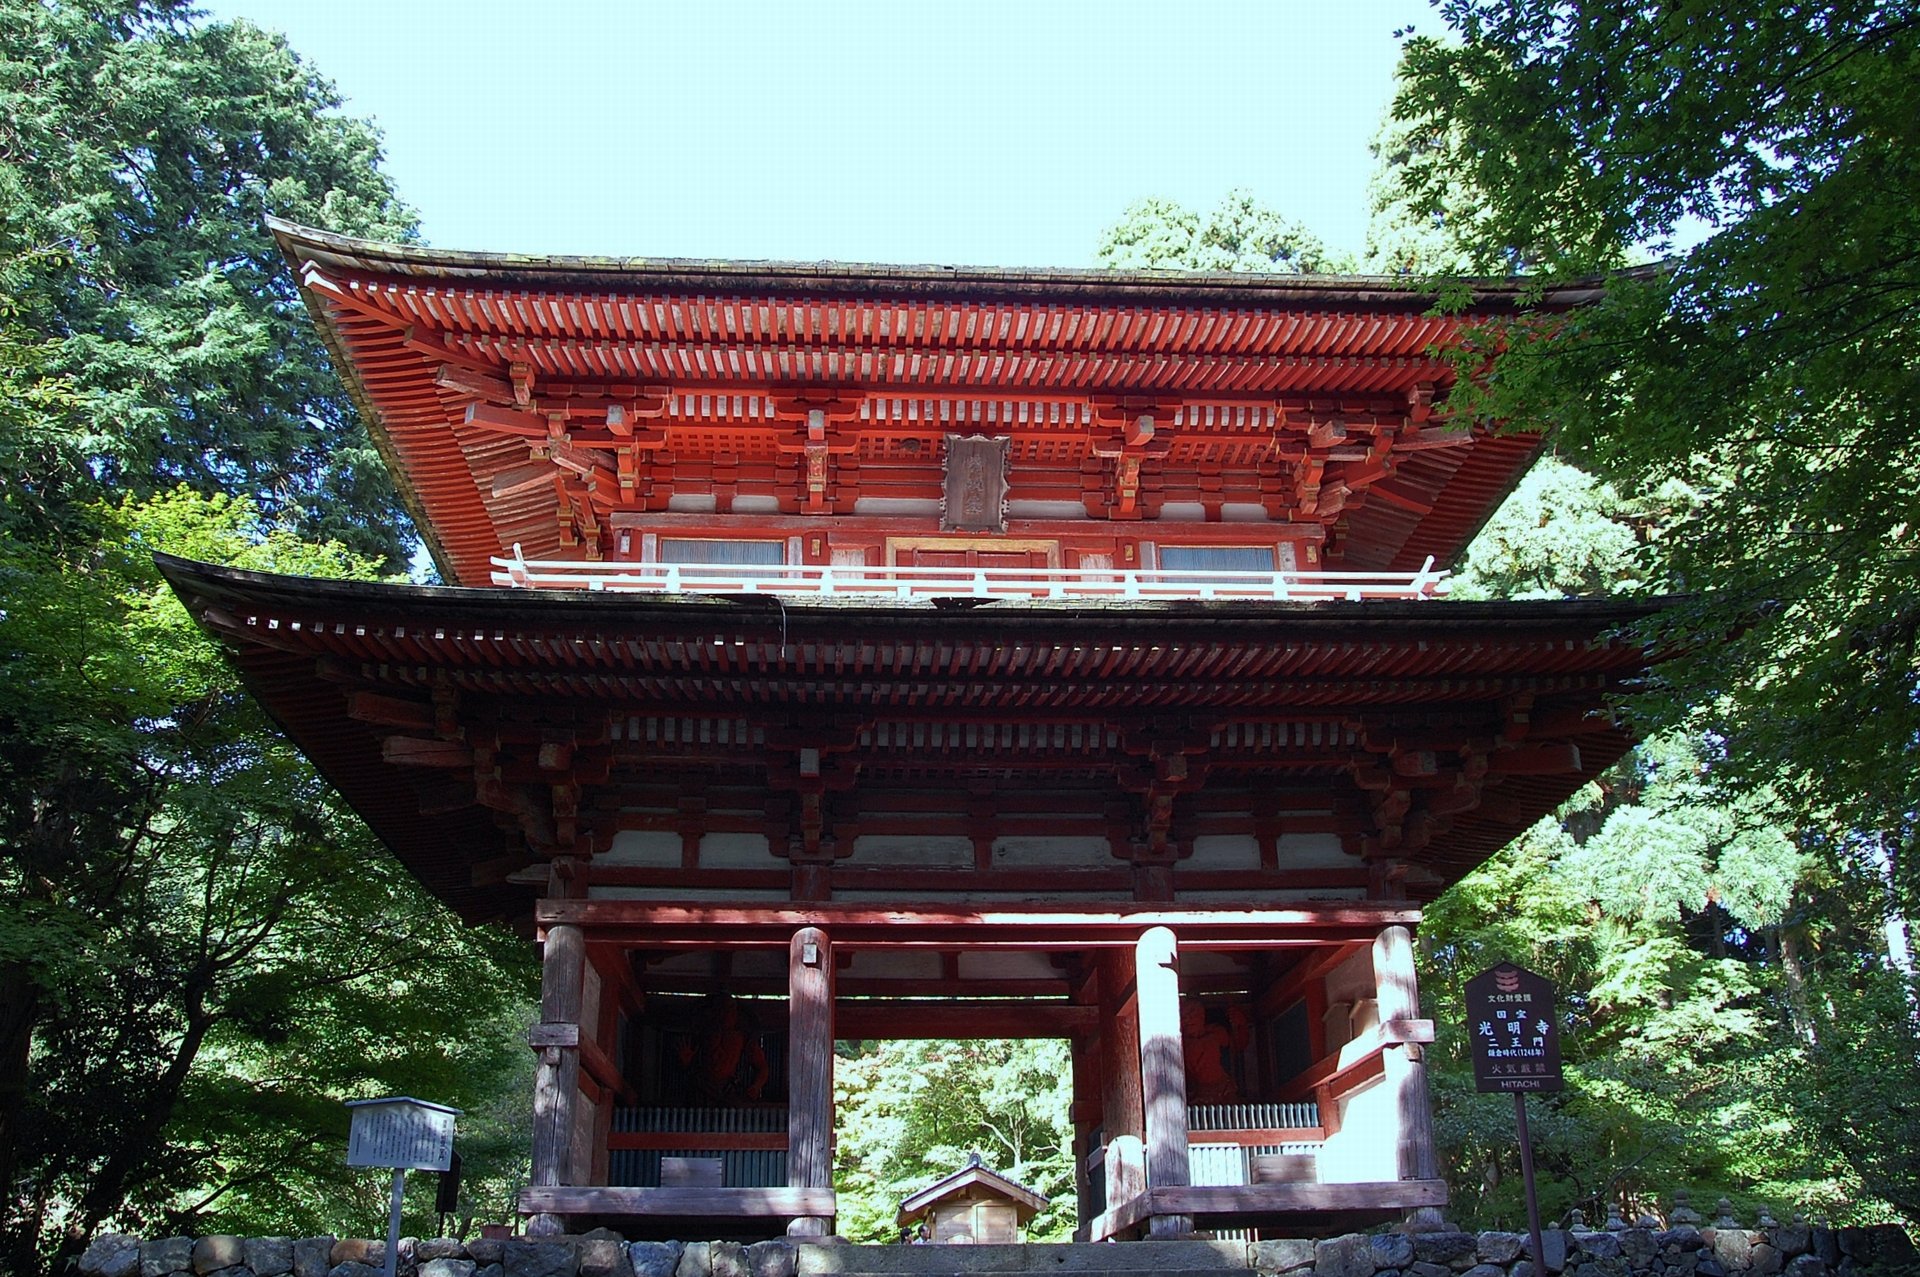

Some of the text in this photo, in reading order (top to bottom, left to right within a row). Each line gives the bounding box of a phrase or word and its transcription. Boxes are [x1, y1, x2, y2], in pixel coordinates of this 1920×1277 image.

[1479, 1019, 1550, 1035] 光明寺
[1488, 1037, 1544, 1048] 二王門
[1501, 1080, 1541, 1089] HITACHI
